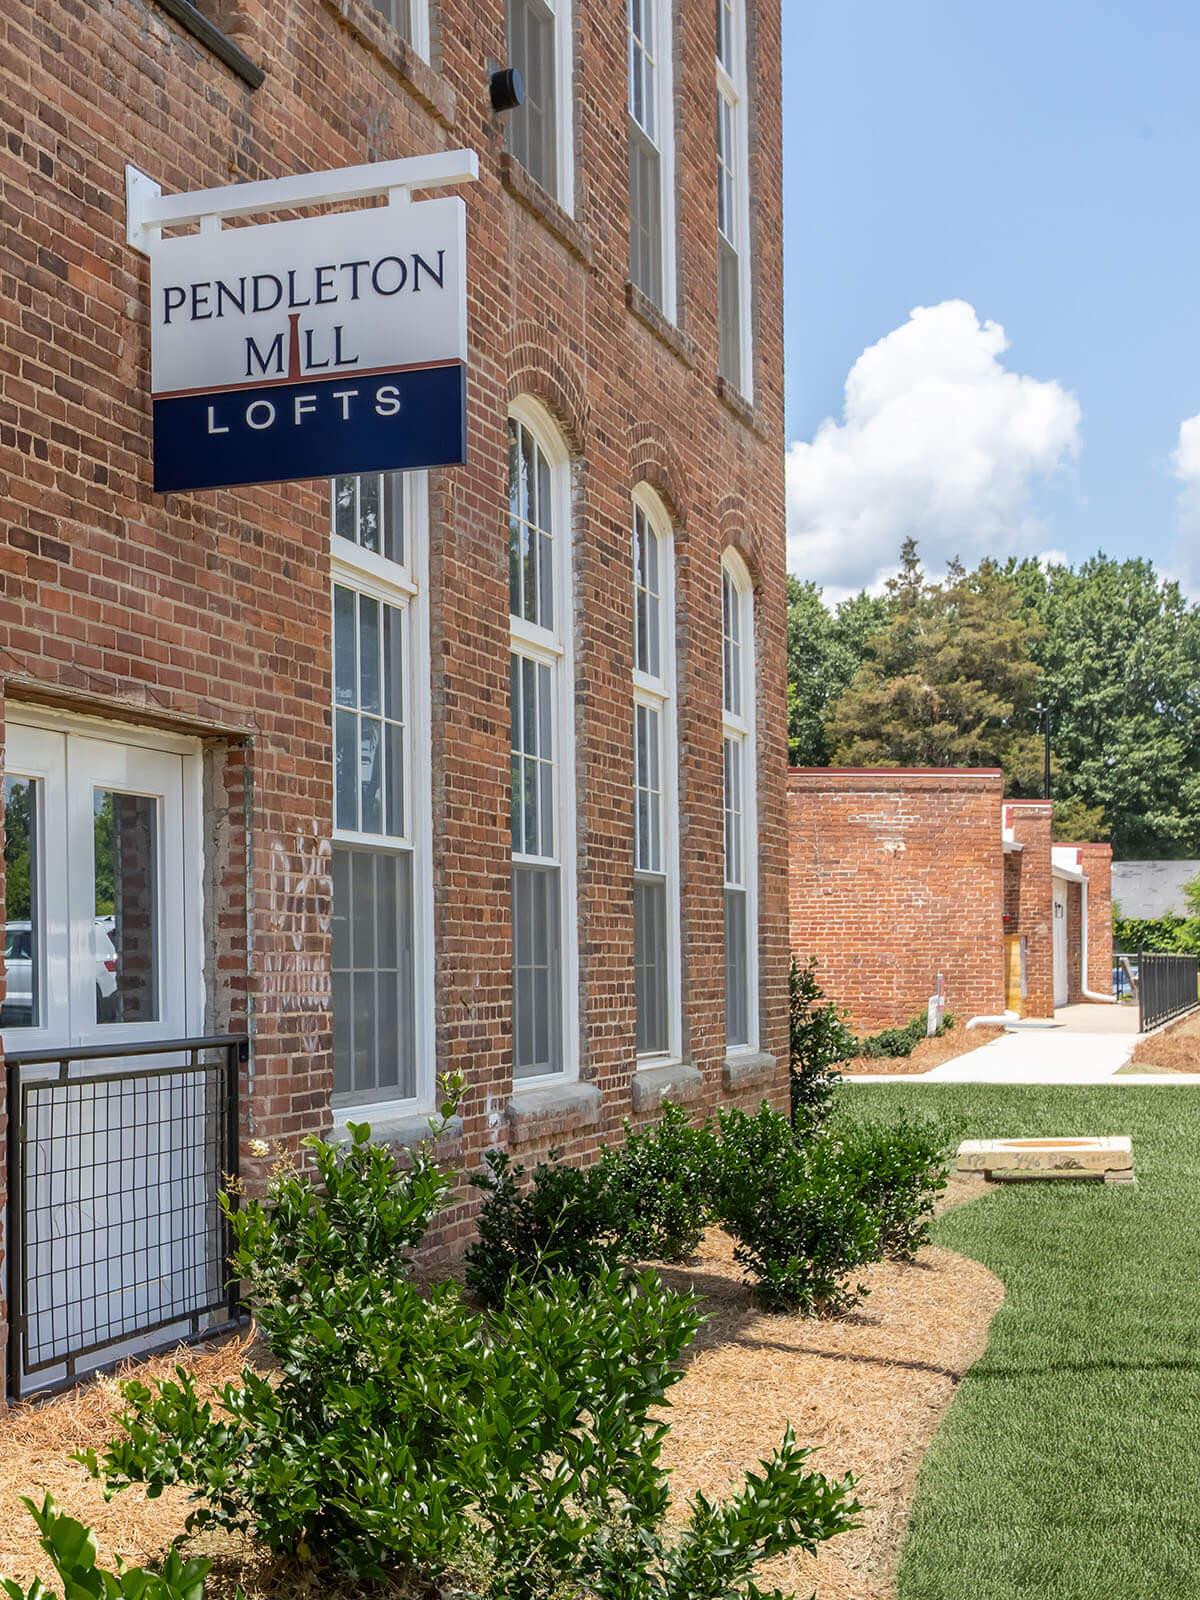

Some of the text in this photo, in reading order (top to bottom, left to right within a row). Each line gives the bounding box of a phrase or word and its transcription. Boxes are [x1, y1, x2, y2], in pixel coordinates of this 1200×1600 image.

[163, 250, 446, 324] PENDLETON
[245, 314, 360, 378] MILL
[207, 385, 402, 435] LOFTS
